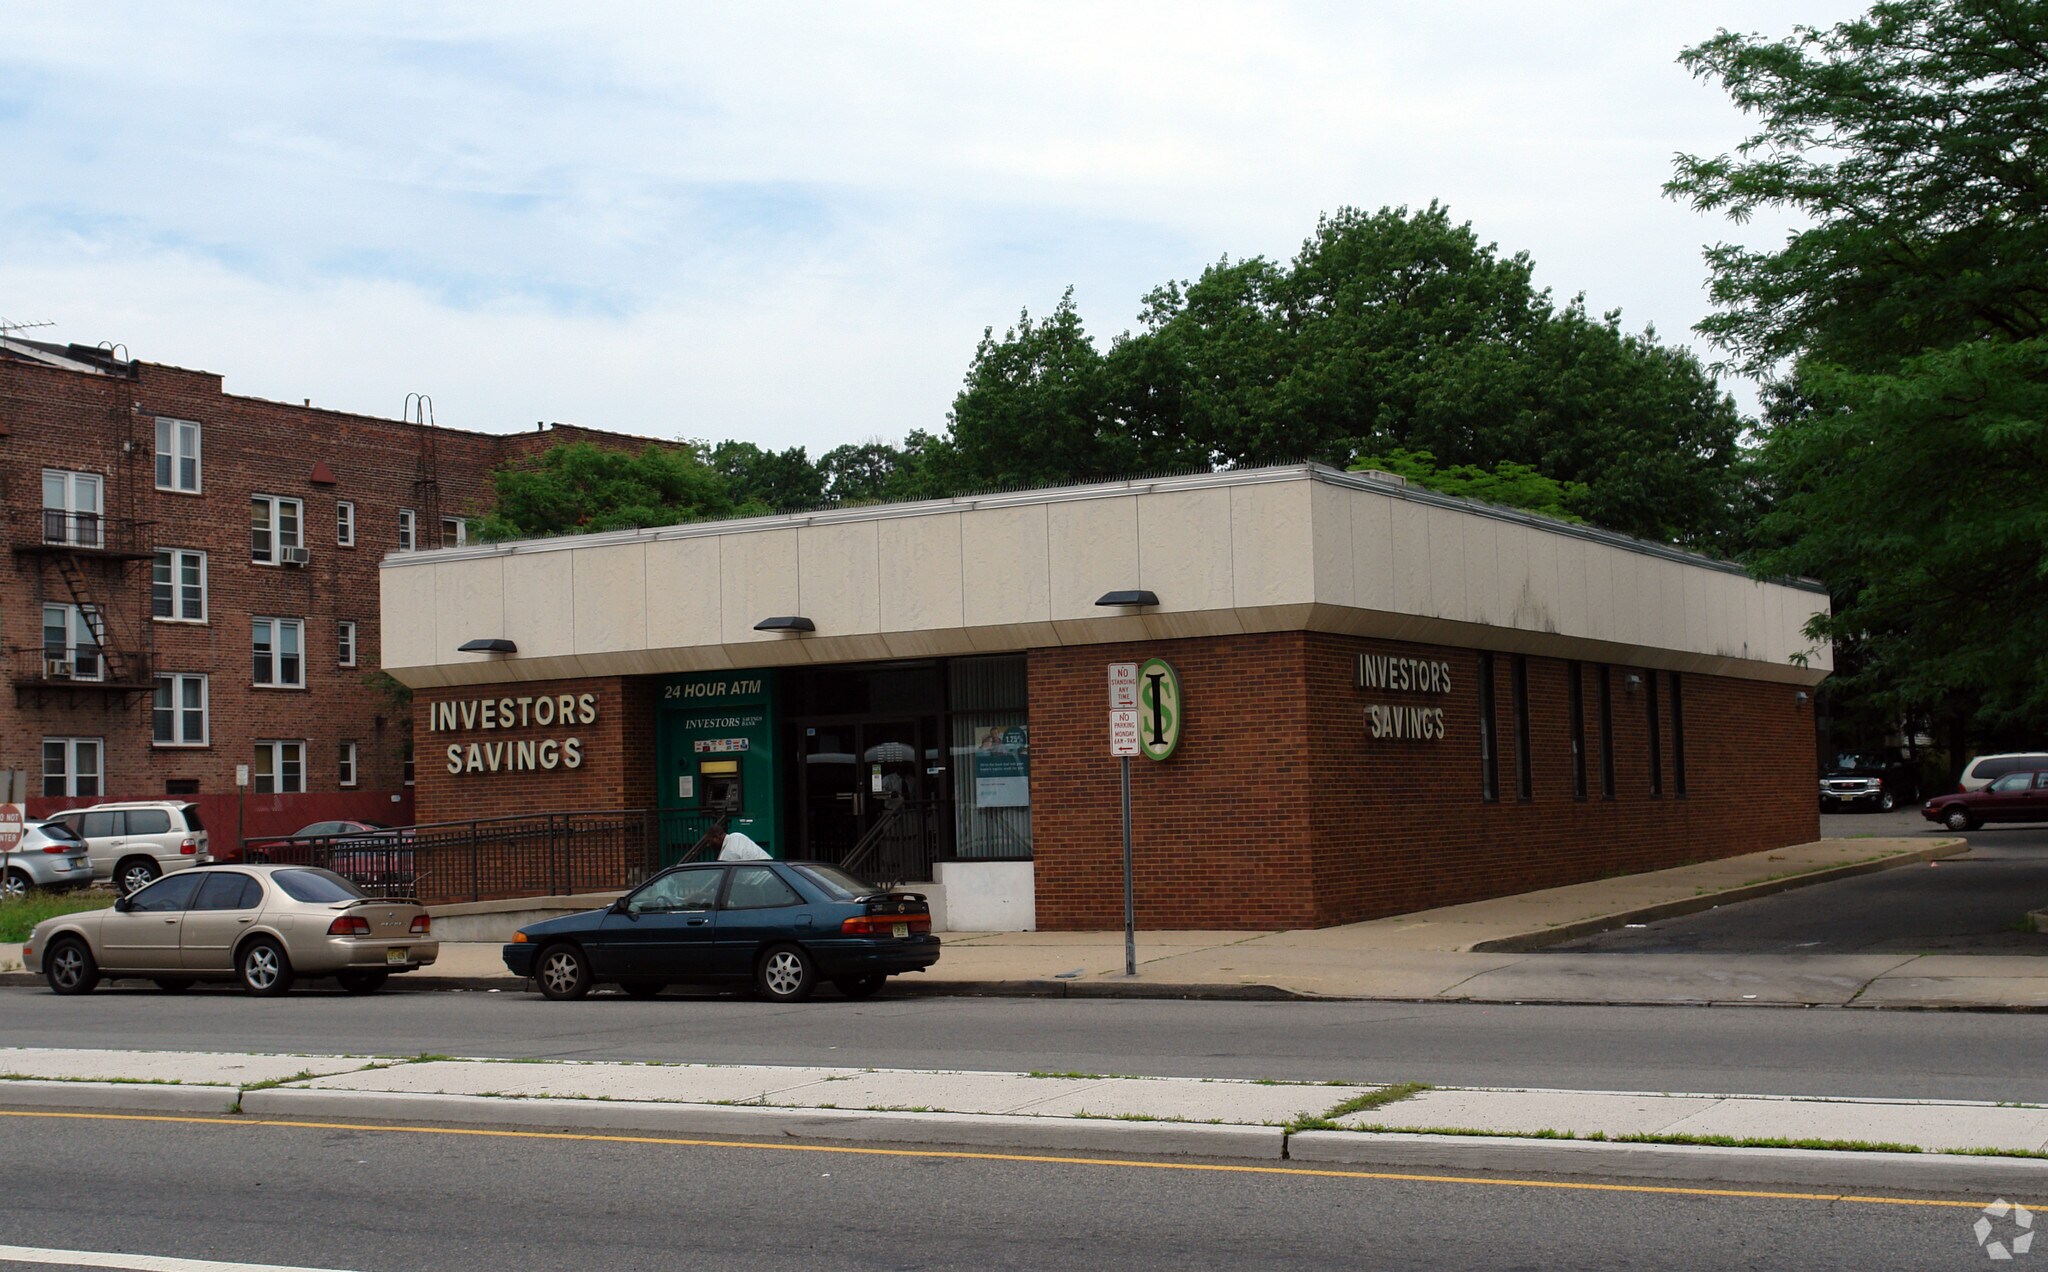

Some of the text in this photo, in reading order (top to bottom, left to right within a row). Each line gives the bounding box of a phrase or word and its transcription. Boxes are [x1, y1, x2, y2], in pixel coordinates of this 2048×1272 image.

[1118, 669, 1128, 677] NO
[1360, 654, 1451, 693] INVESTORS
[664, 680, 761, 698] 24 HOUR ATM
[430, 694, 596, 731] INVESTORS
[1371, 704, 1445, 739] SAVINGS
[685, 717, 740, 729] INVESTORS
[447, 737, 581, 774] SAVINGS
[6, 813, 18, 822] NOT
[0, 833, 16, 842] NTER
